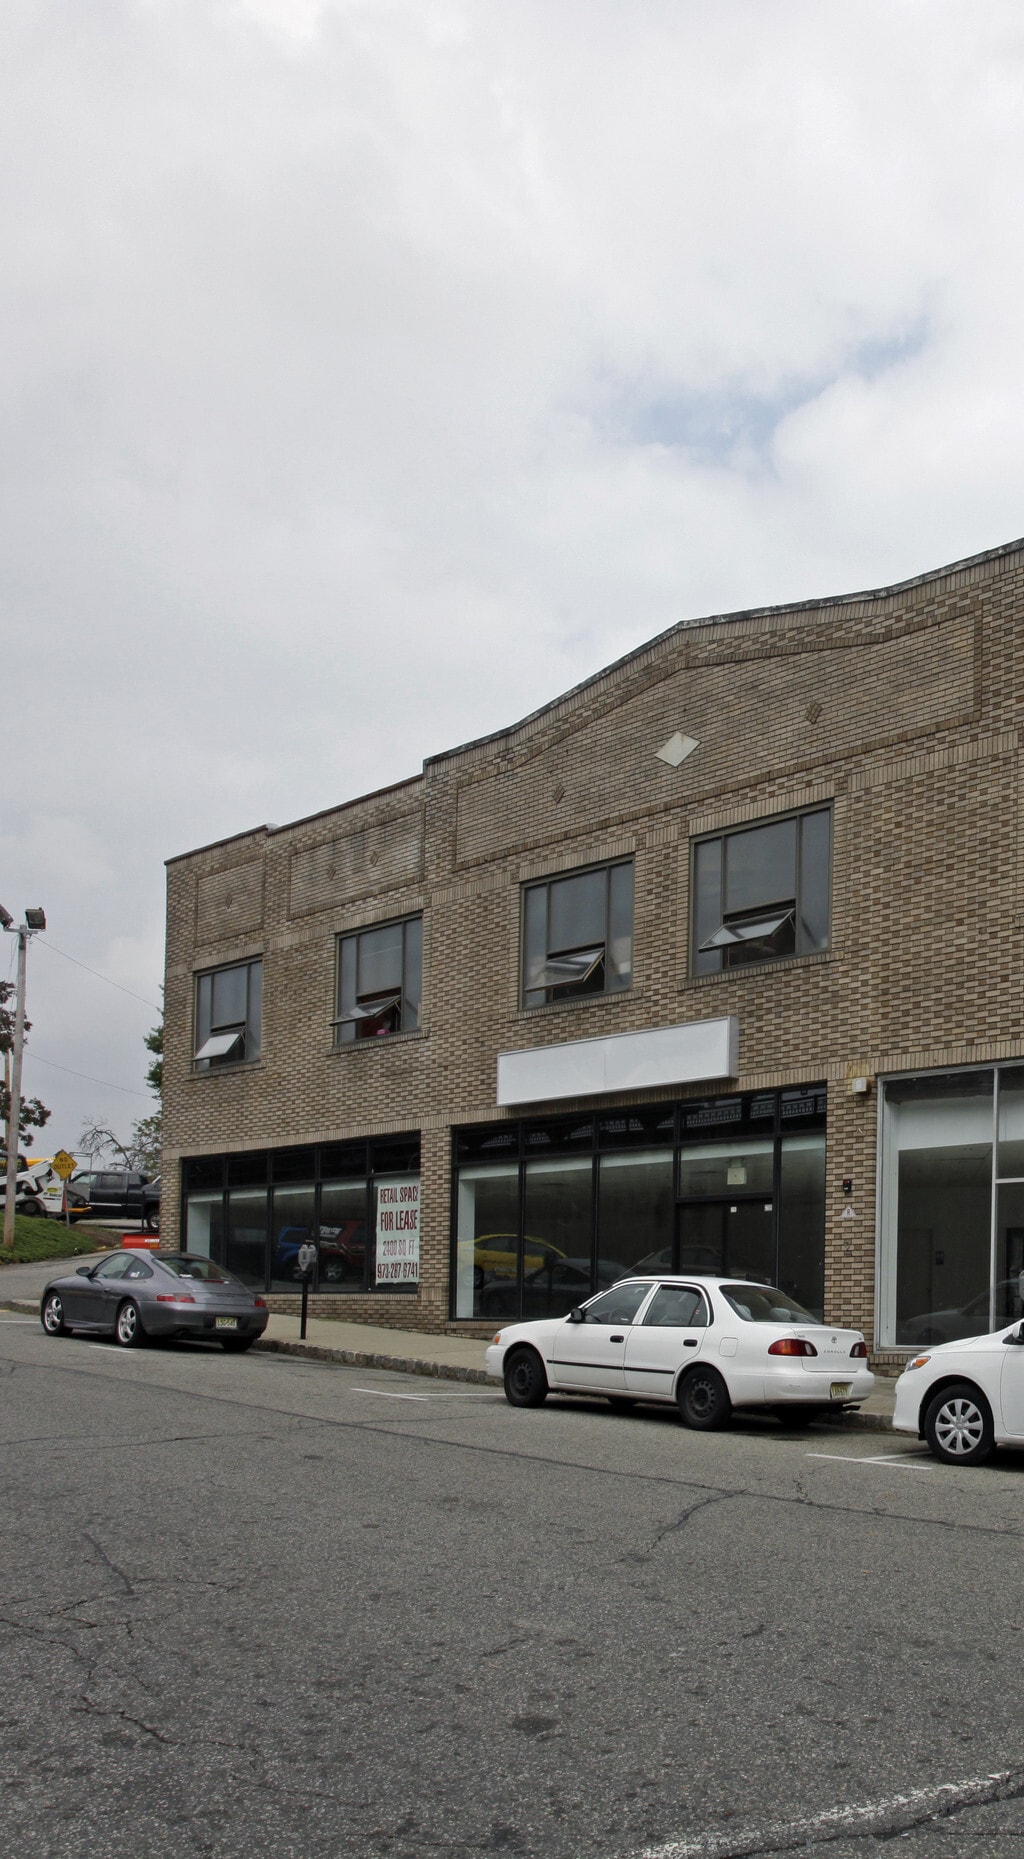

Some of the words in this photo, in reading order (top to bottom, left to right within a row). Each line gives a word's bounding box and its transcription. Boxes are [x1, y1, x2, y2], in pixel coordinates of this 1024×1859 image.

[380, 1188, 398, 1204] RETAIL
[380, 1211, 394, 1232] FOR
[396, 1209, 418, 1231] LEASE
[383, 1240, 397, 1256] 2400
[408, 1240, 415, 1255] FT
